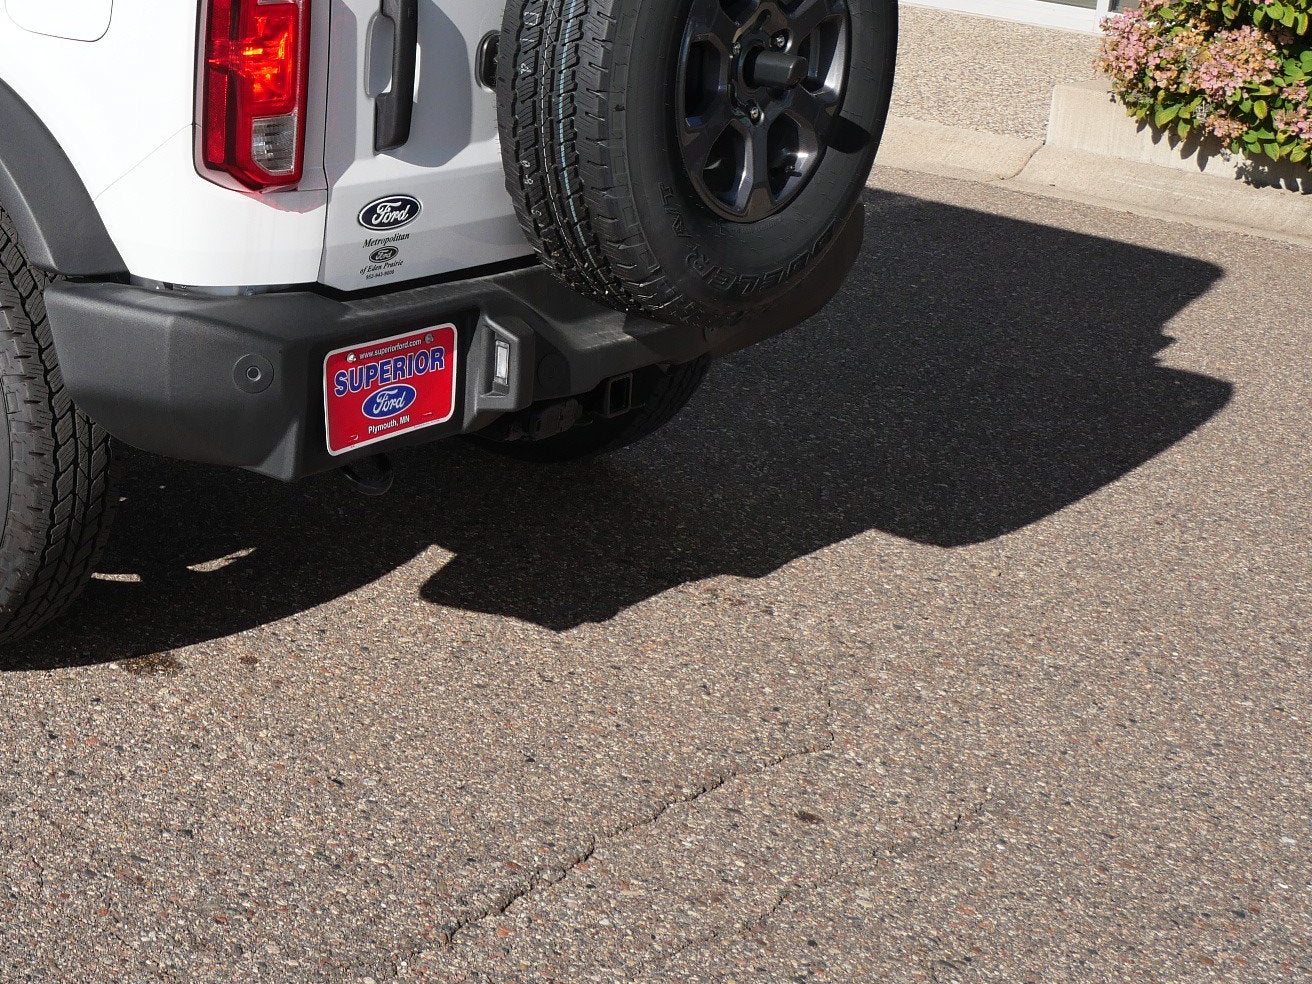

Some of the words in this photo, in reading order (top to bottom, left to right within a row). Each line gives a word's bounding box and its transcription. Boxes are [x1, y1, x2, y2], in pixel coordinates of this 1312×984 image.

[371, 201, 411, 225] Ford
[362, 232, 410, 248] Metropolitan
[382, 259, 404, 270] Prairie
[359, 338, 423, 359] www.superiorford.com
[334, 346, 445, 397] SUPERIOR
[372, 389, 406, 415] Ford
[368, 418, 399, 434] Plymouth,
[399, 415, 410, 424] MN
